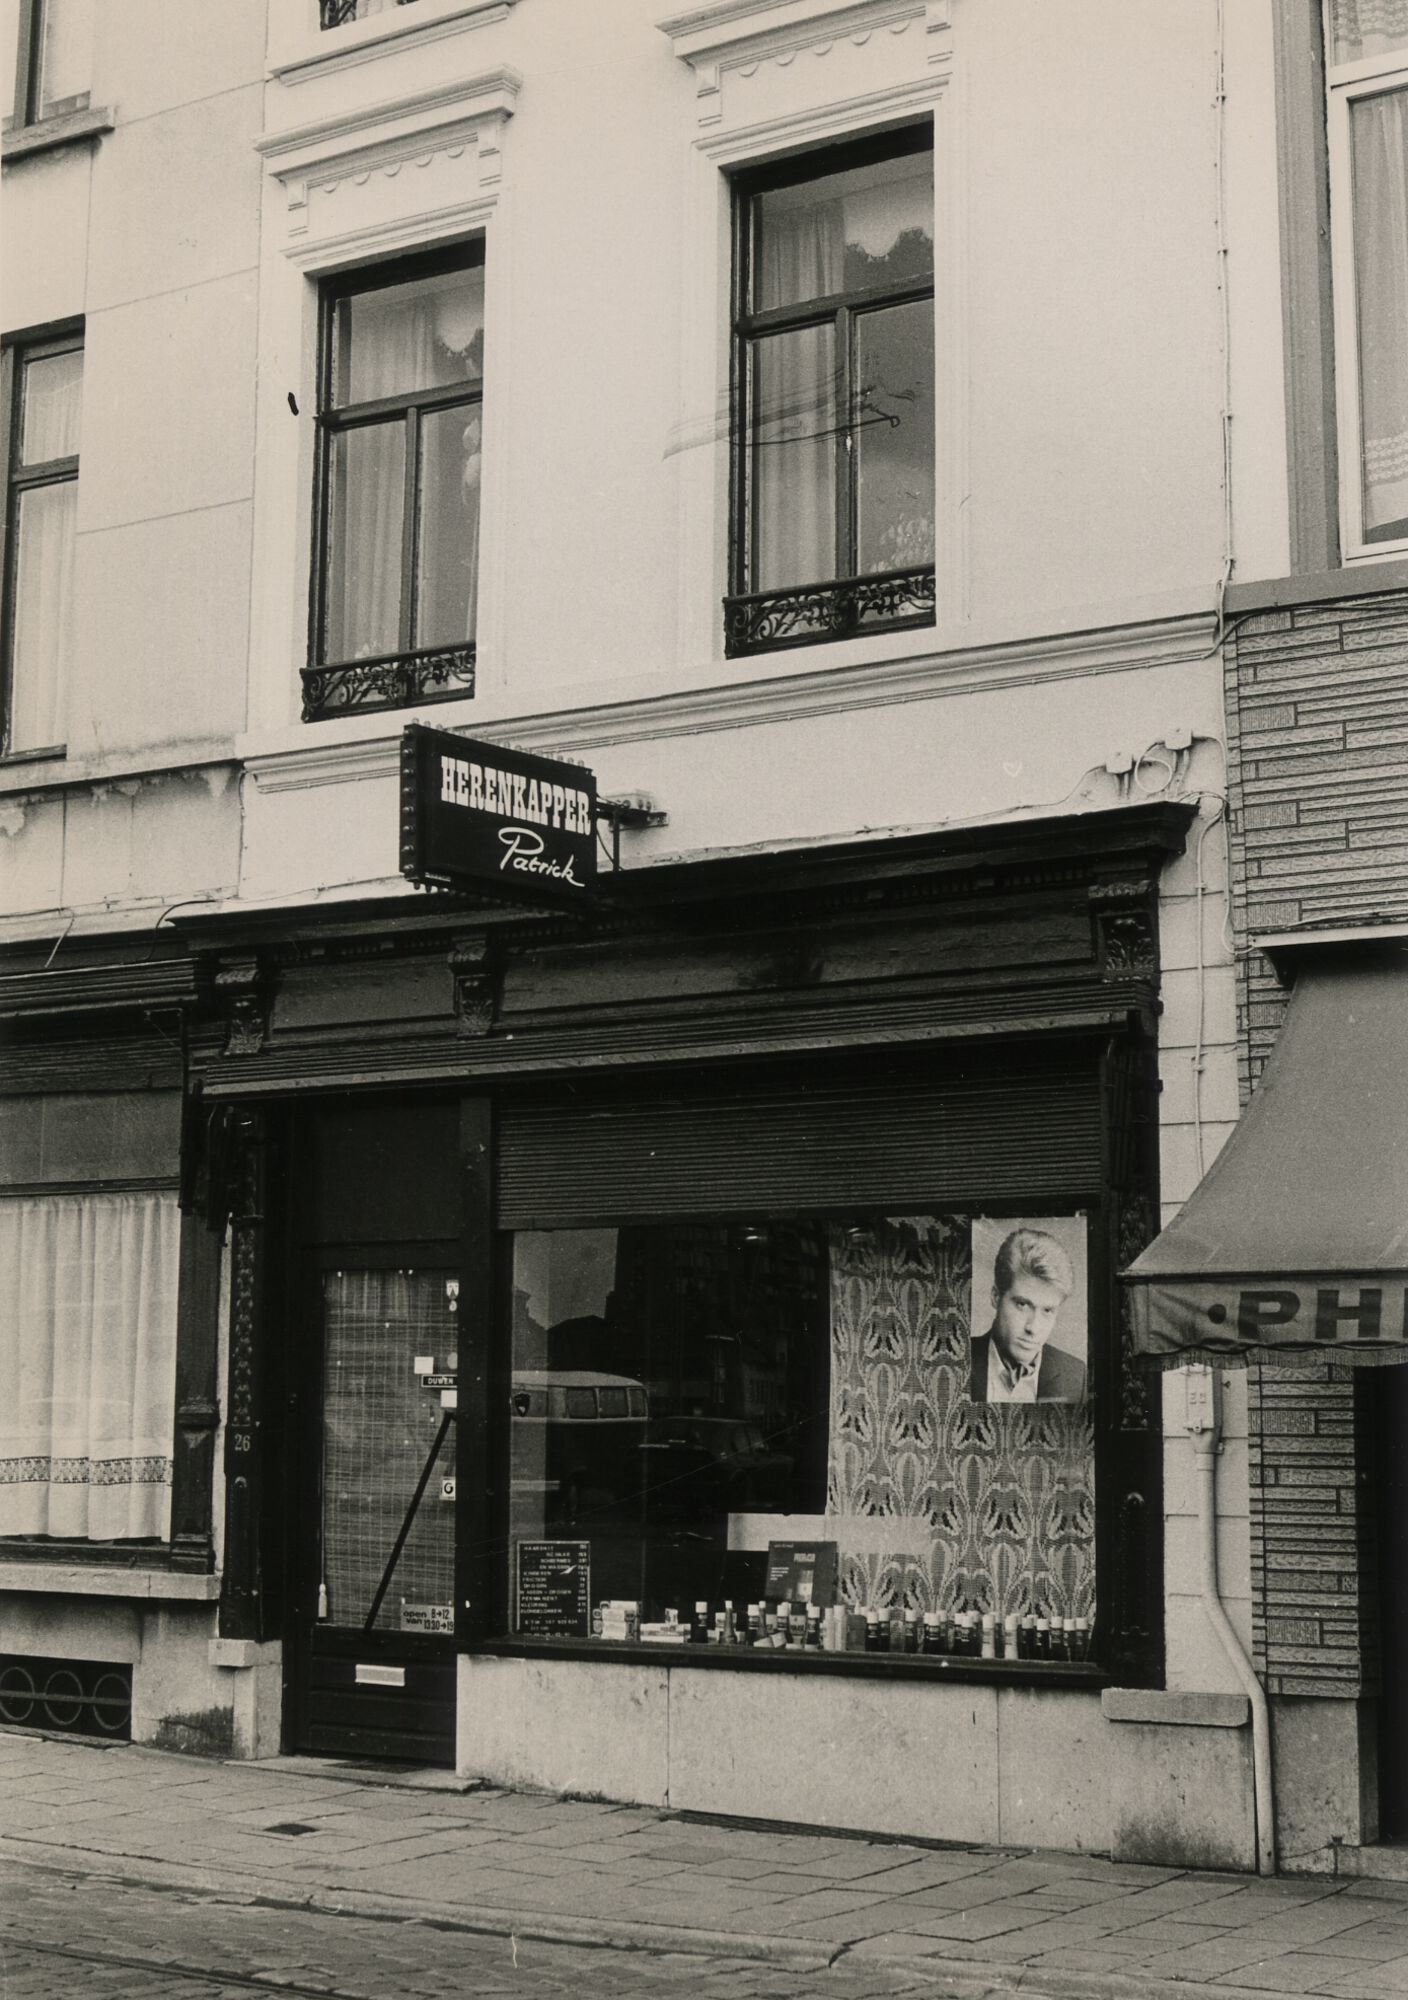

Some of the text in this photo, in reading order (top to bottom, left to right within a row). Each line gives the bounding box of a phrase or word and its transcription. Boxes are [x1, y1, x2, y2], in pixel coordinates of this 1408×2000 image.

[441, 755, 591, 836] HERENKAPPER
[498, 827, 586, 887] Patrick
[234, 1433, 251, 1451] 26
